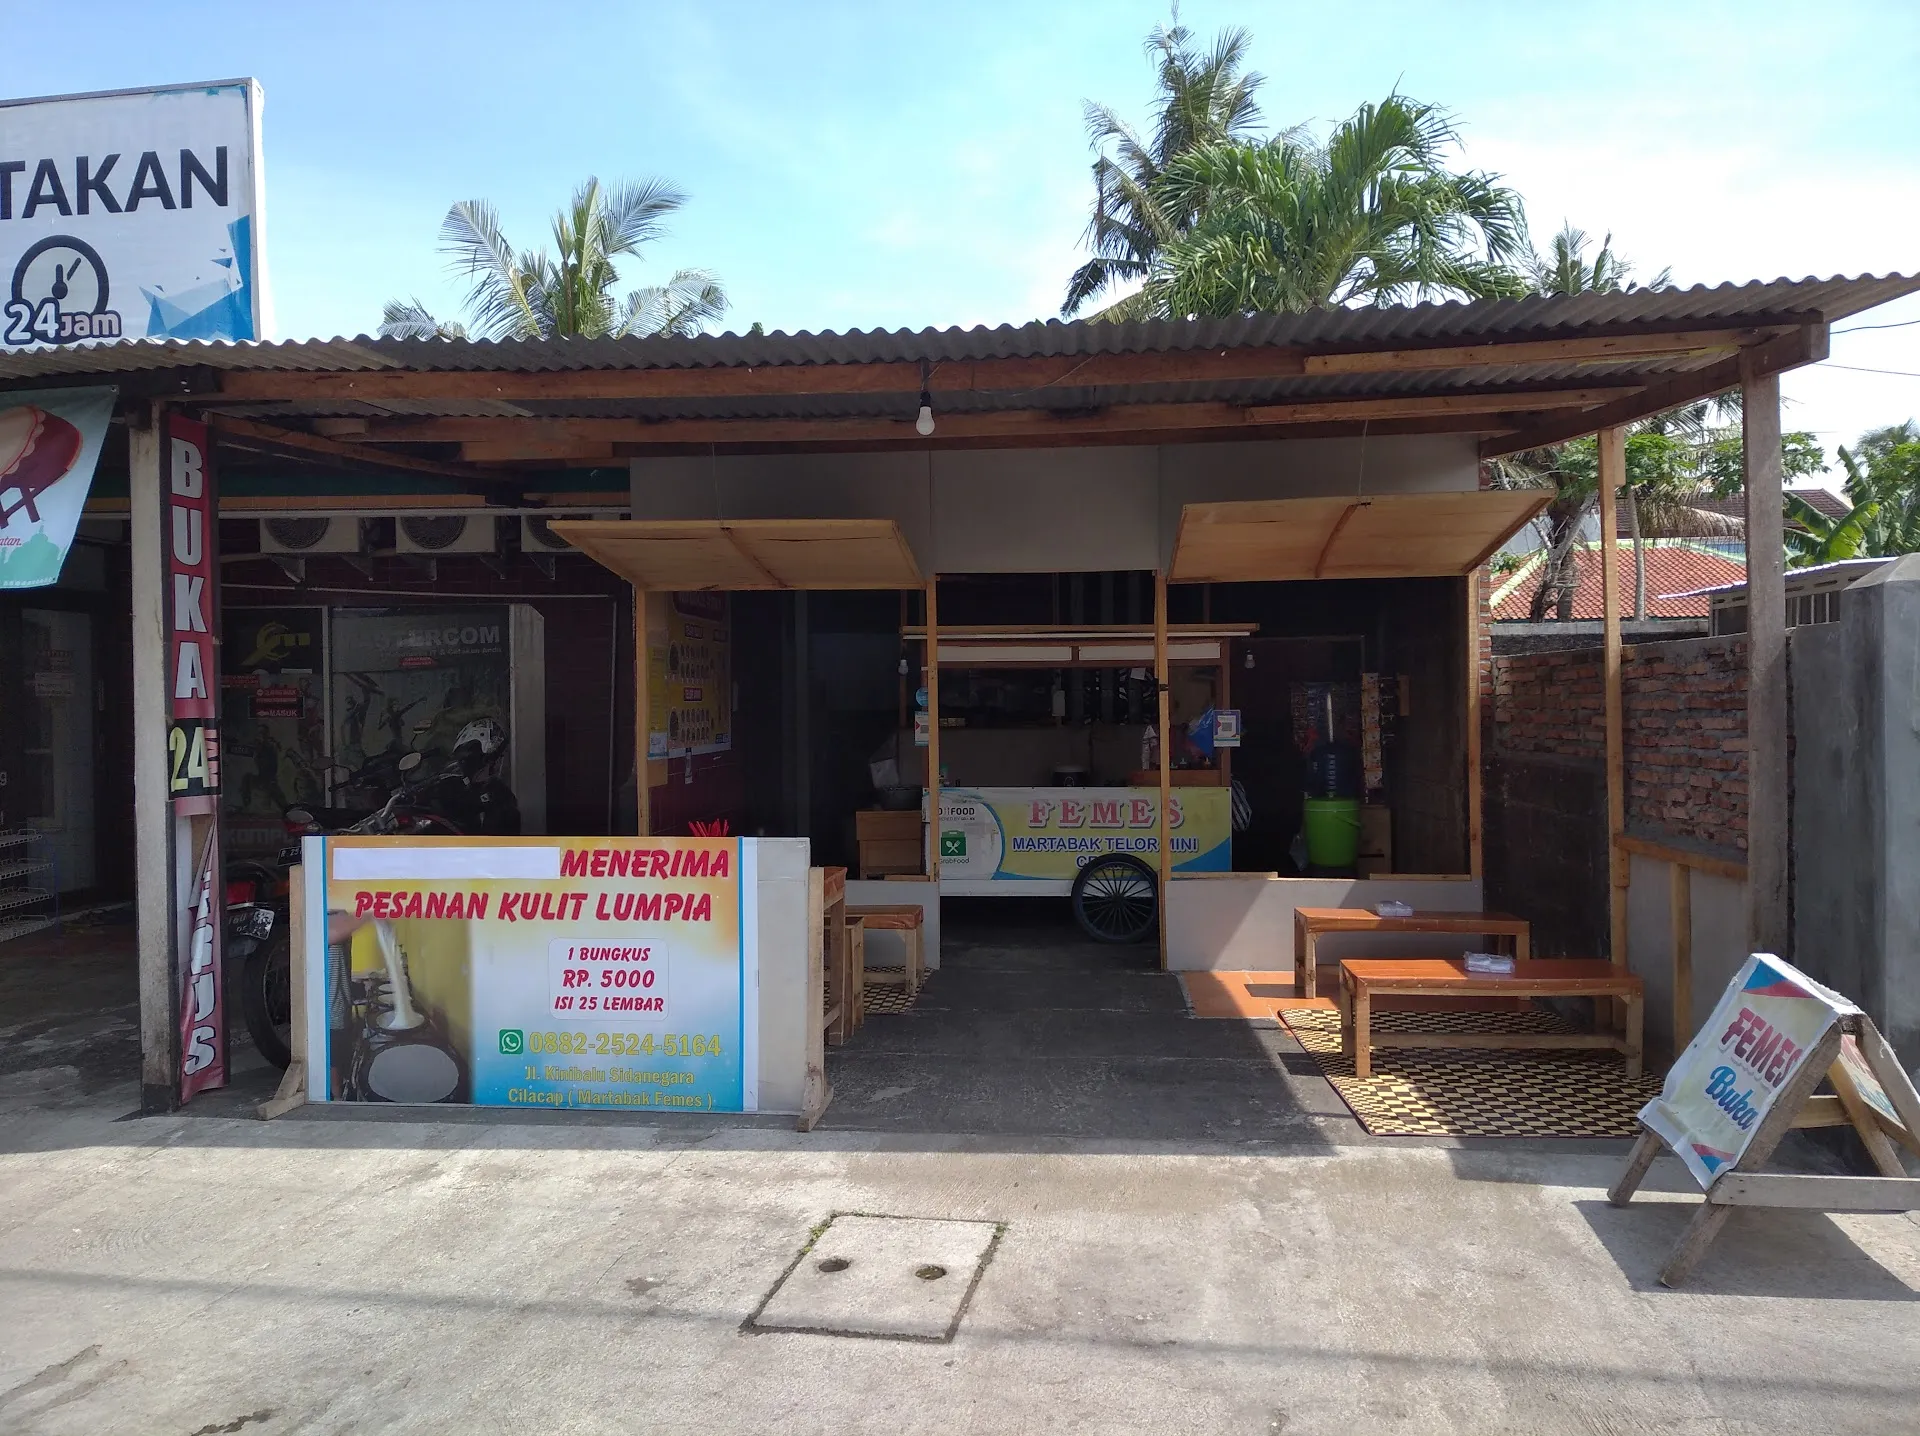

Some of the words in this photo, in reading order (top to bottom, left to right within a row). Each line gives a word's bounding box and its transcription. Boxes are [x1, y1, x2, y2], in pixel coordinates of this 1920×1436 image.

[171, 437, 208, 700] BUKA
[169, 726, 211, 792] 24
[950, 807, 975, 816] FOOD
[1028, 799, 1185, 828] FEMES
[1012, 837, 1102, 852] MARTABAK
[1104, 837, 1160, 852] TELOR
[560, 849, 729, 878] MENERIMA
[354, 891, 489, 921] PESANAN
[497, 892, 588, 923] KULIT
[595, 893, 712, 922] LUMPIA
[568, 947, 575, 961] 1
[579, 947, 651, 962] BUNGKUS
[562, 969, 592, 988] RP.
[600, 969, 655, 988] 5000
[554, 996, 574, 1010] ISI
[578, 996, 598, 1010] 25
[602, 996, 664, 1012] LEMBAR
[529, 1031, 722, 1057] 0882-2524-5164
[1721, 1007, 1803, 1089] FEMES
[524, 1066, 541, 1080] Jl.
[545, 1066, 606, 1082] Kinibalu
[608, 1068, 695, 1087] Sidanegara
[507, 1088, 563, 1106] Cilacap
[578, 1089, 650, 1107] Martabak
[654, 1091, 703, 1107] Femes
[1705, 1066, 1760, 1131] Buka
